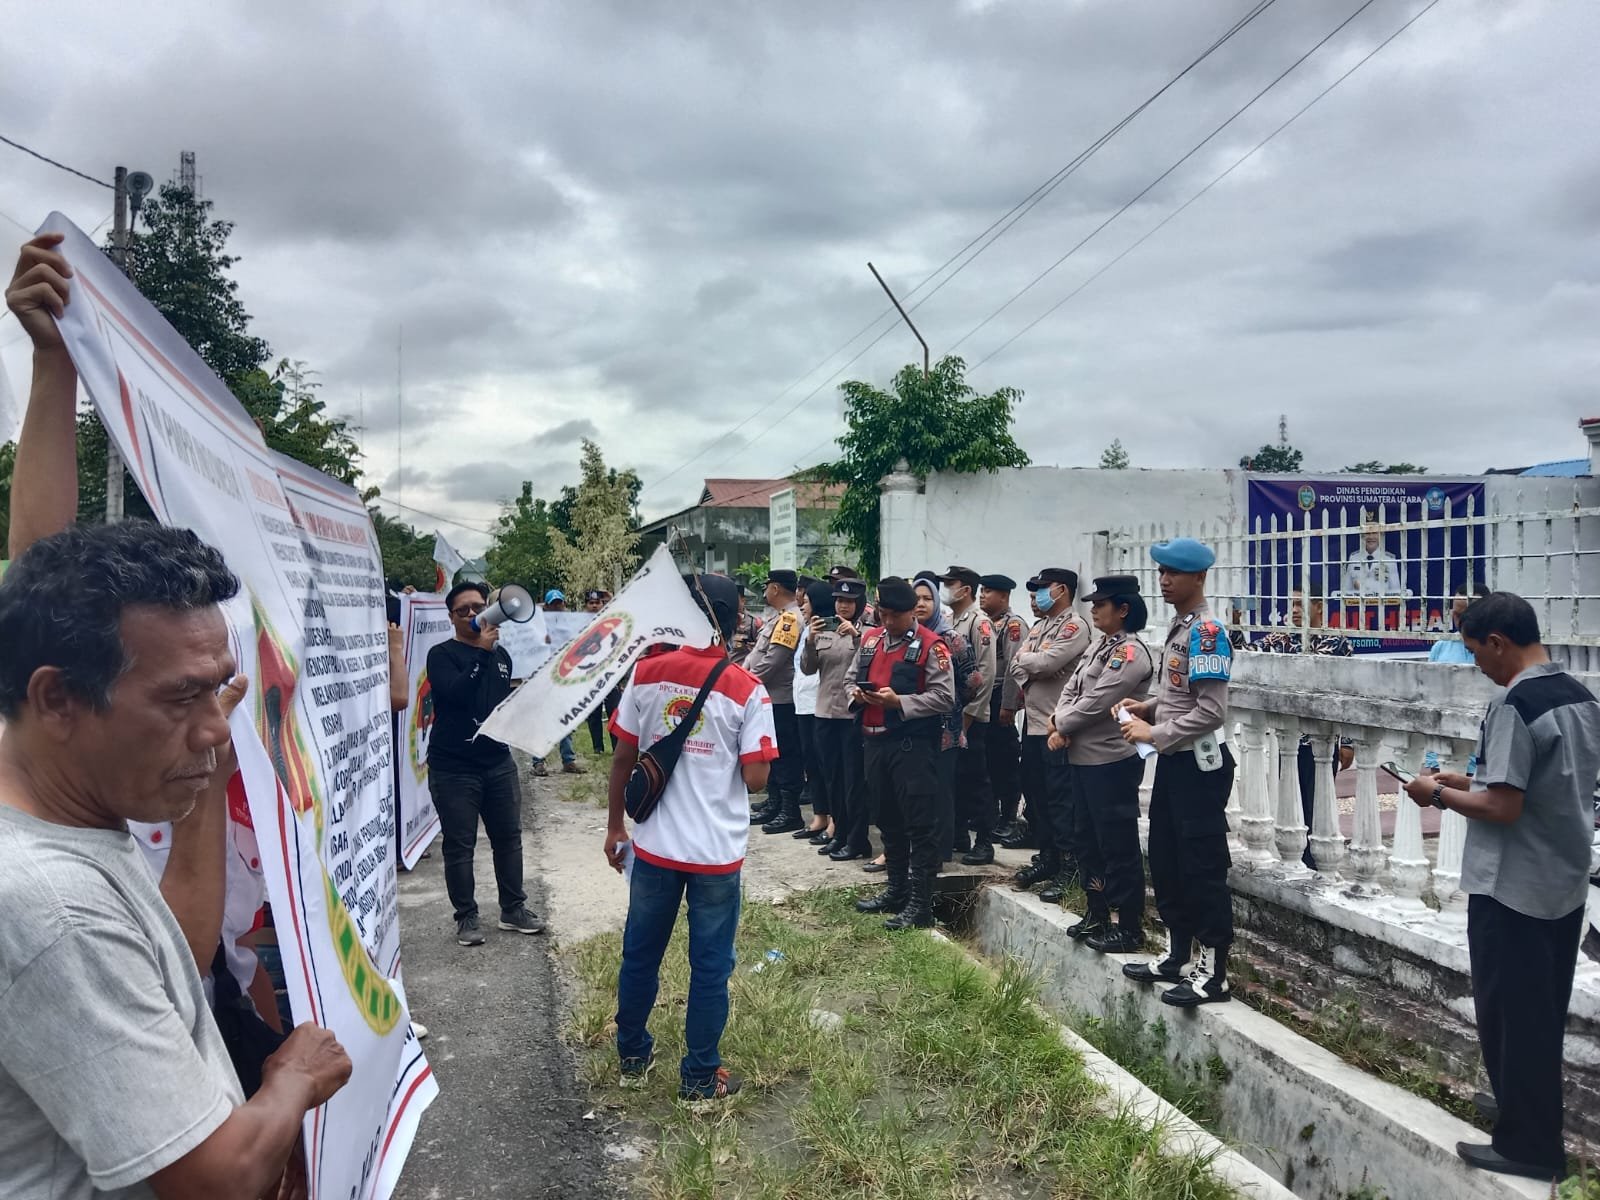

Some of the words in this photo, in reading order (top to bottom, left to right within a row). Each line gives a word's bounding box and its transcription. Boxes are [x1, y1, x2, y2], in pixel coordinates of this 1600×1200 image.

[1336, 487, 1360, 495] DINAS
[1360, 487, 1406, 496] PENDIDIKAN
[1319, 495, 1356, 503] PROVINSI
[1356, 495, 1396, 504] SUMATERA
[1397, 495, 1422, 504] UTARA
